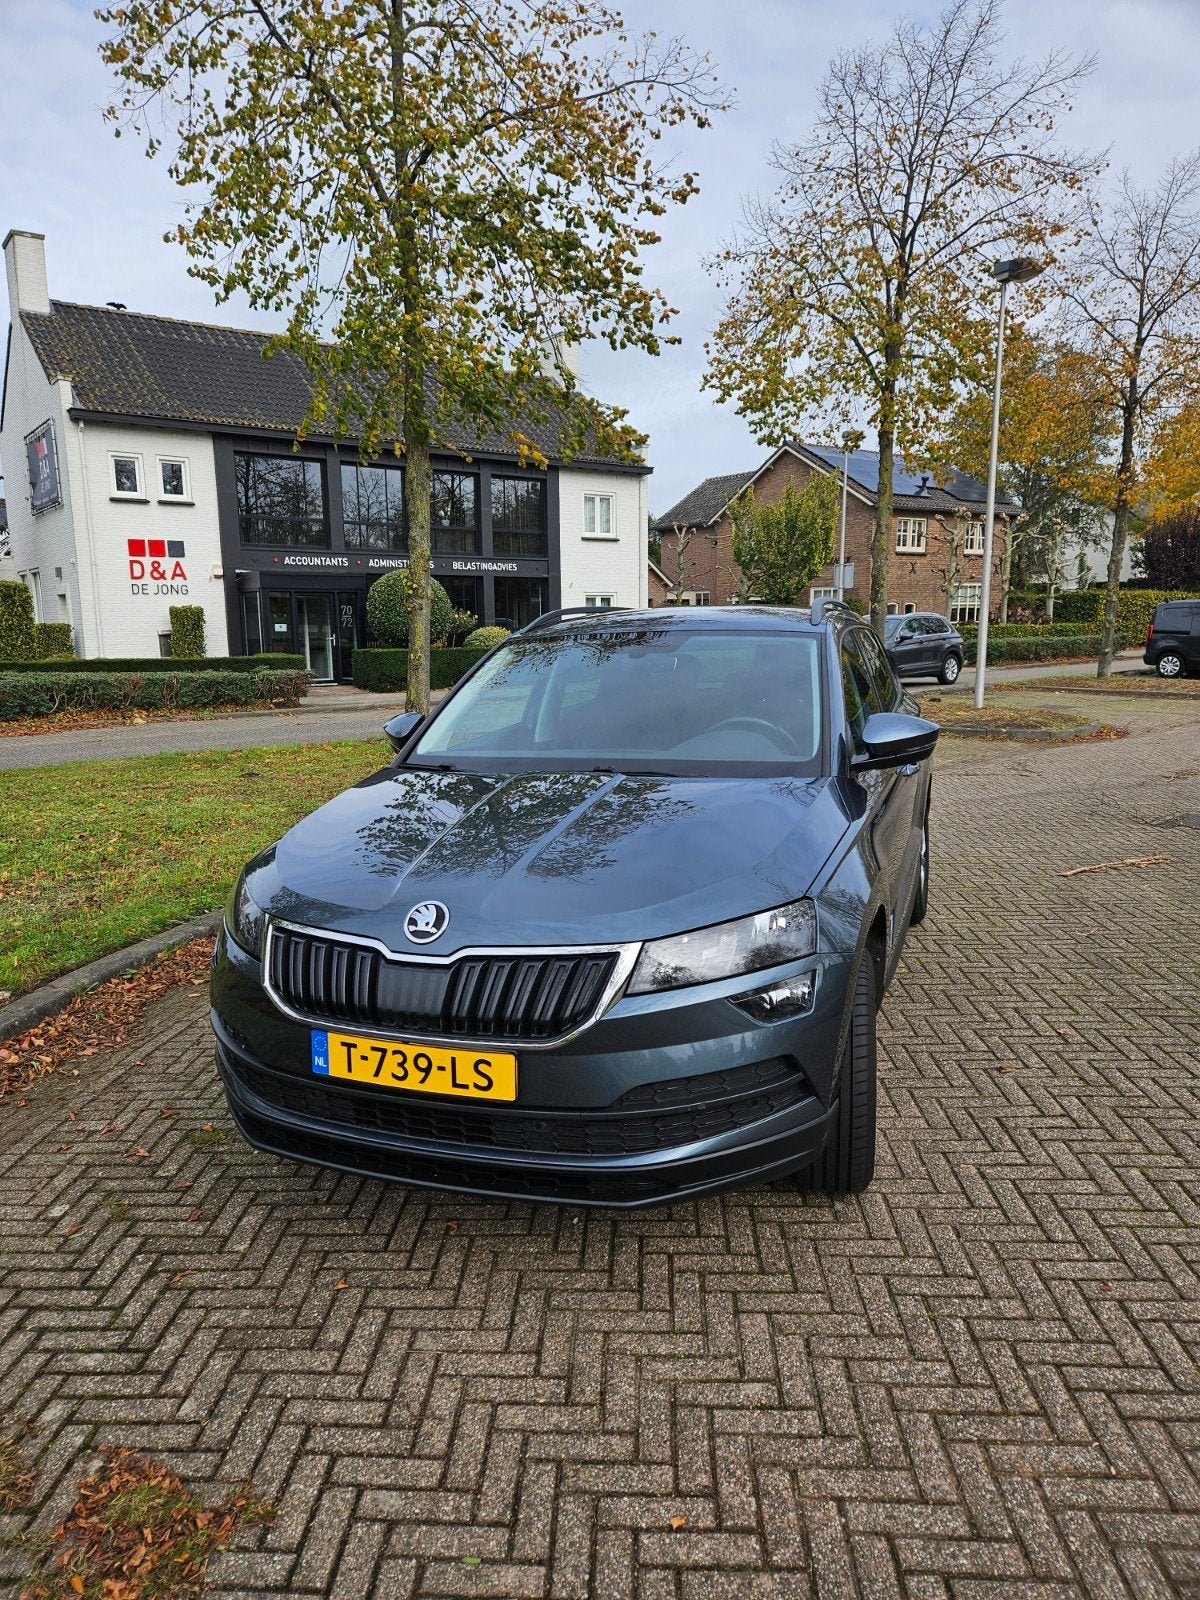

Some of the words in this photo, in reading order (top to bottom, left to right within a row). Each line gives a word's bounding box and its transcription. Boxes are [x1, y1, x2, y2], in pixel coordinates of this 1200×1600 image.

[129, 559, 187, 580] D&A
[283, 556, 349, 566] ACCOUNTANTS
[368, 558, 435, 569] ADMINISTS
[452, 561, 518, 571] BELASTINGADVIES
[131, 583, 149, 595] DE
[153, 583, 189, 595] JONG
[341, 605, 353, 615] 70
[341, 617, 353, 627] 72
[314, 1055, 328, 1068] NL
[340, 1040, 494, 1092] T-739-LS
